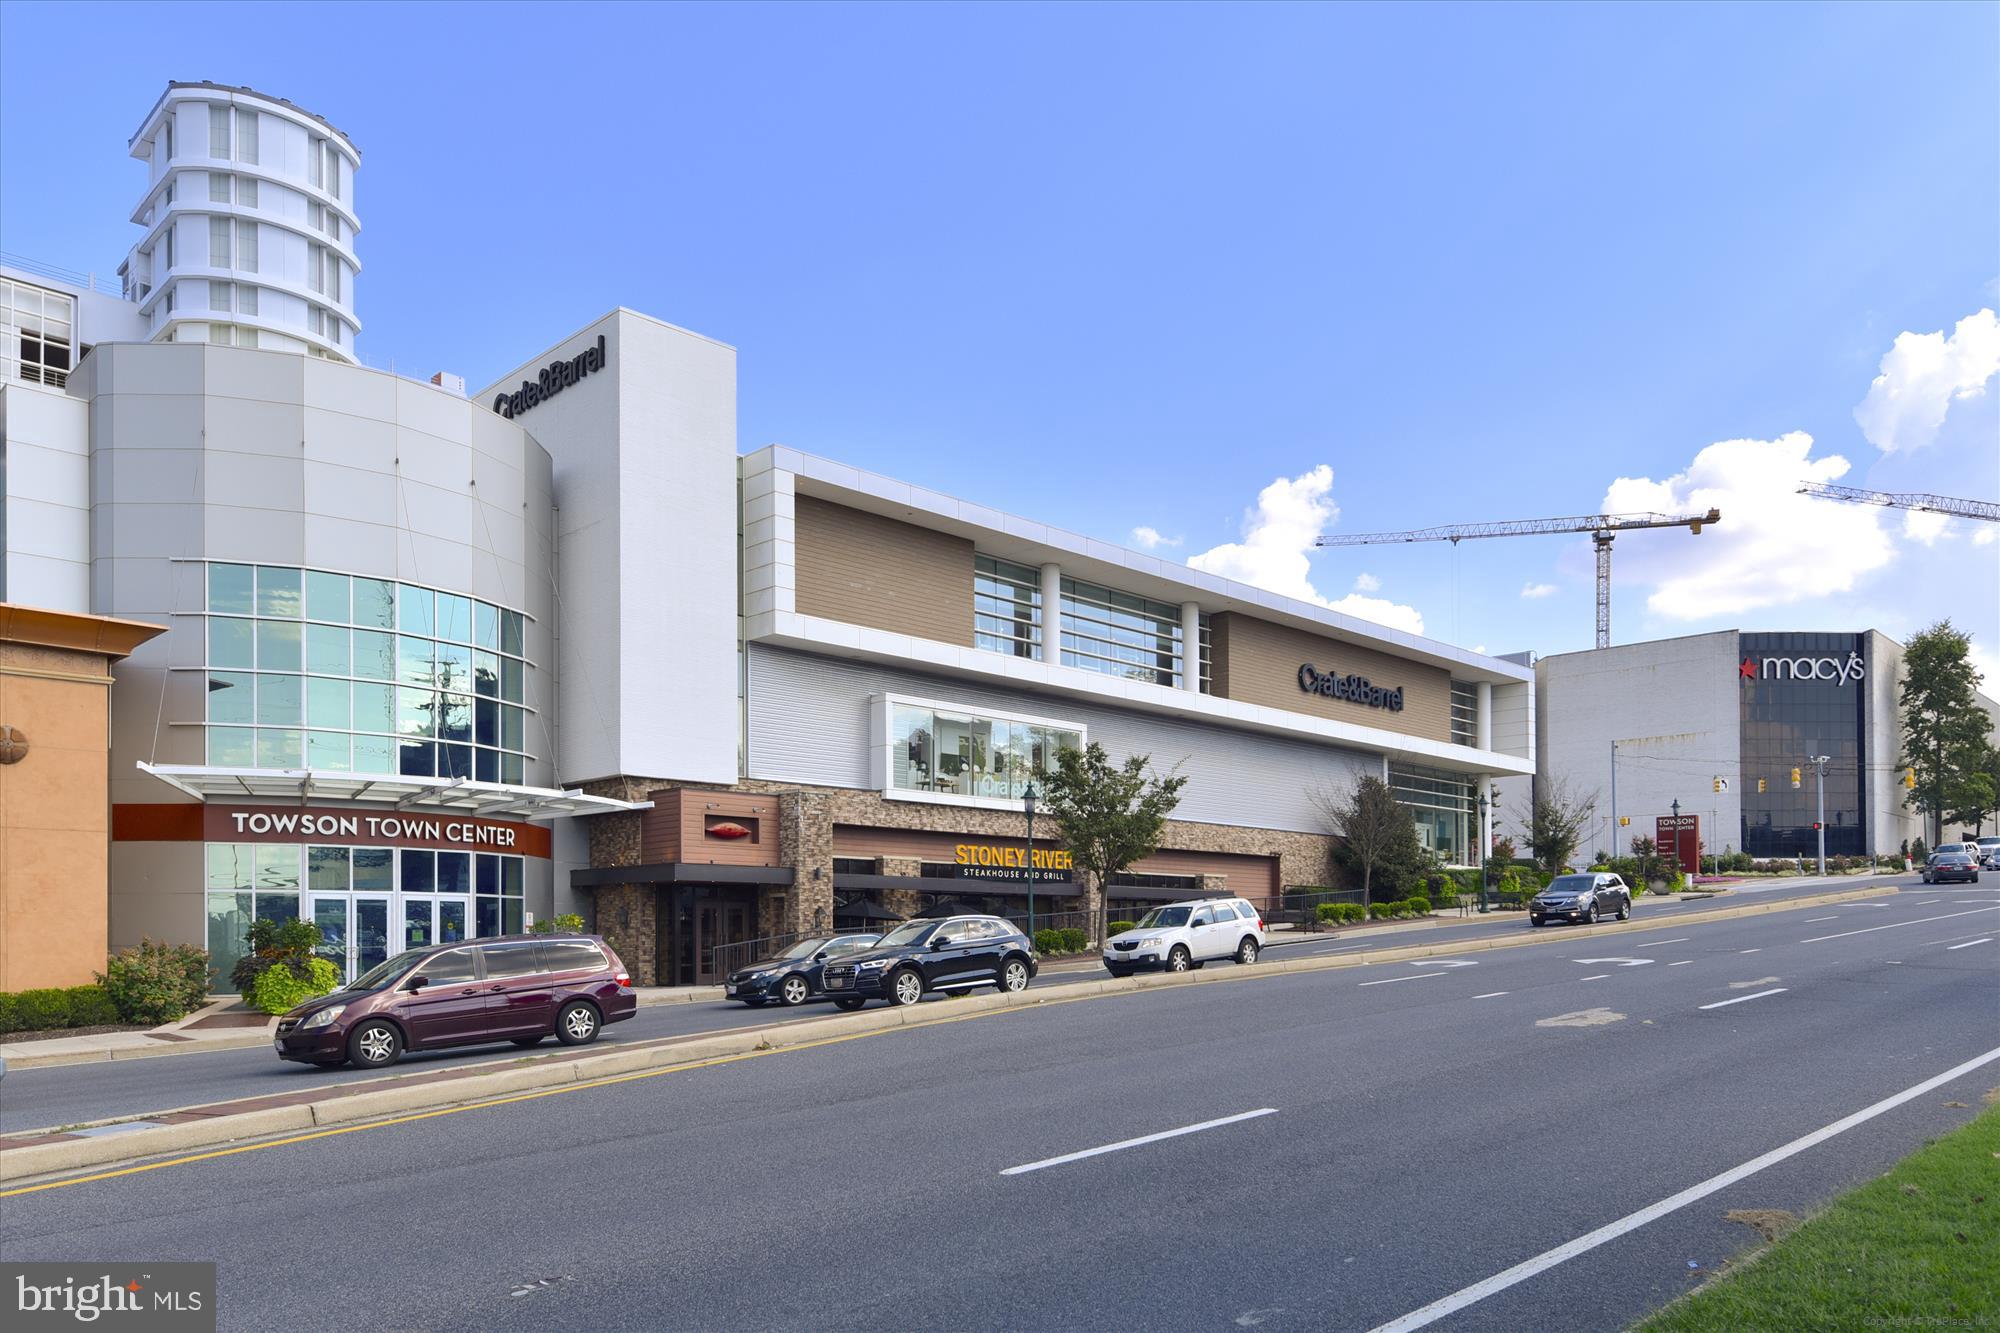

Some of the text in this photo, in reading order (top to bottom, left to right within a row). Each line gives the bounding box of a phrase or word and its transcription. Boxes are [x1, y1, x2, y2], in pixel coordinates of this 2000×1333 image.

[1763, 651, 1865, 686] macy's
[1298, 663, 1403, 712] Crate&Barrel
[232, 812, 516, 847] TOWSON TOWN CENTER
[1659, 818, 1695, 826] TOWSON
[955, 844, 1074, 870] STONEY RIVER
[963, 867, 1020, 879] STEAKHOUSE
[1043, 872, 1064, 880] GRILL
